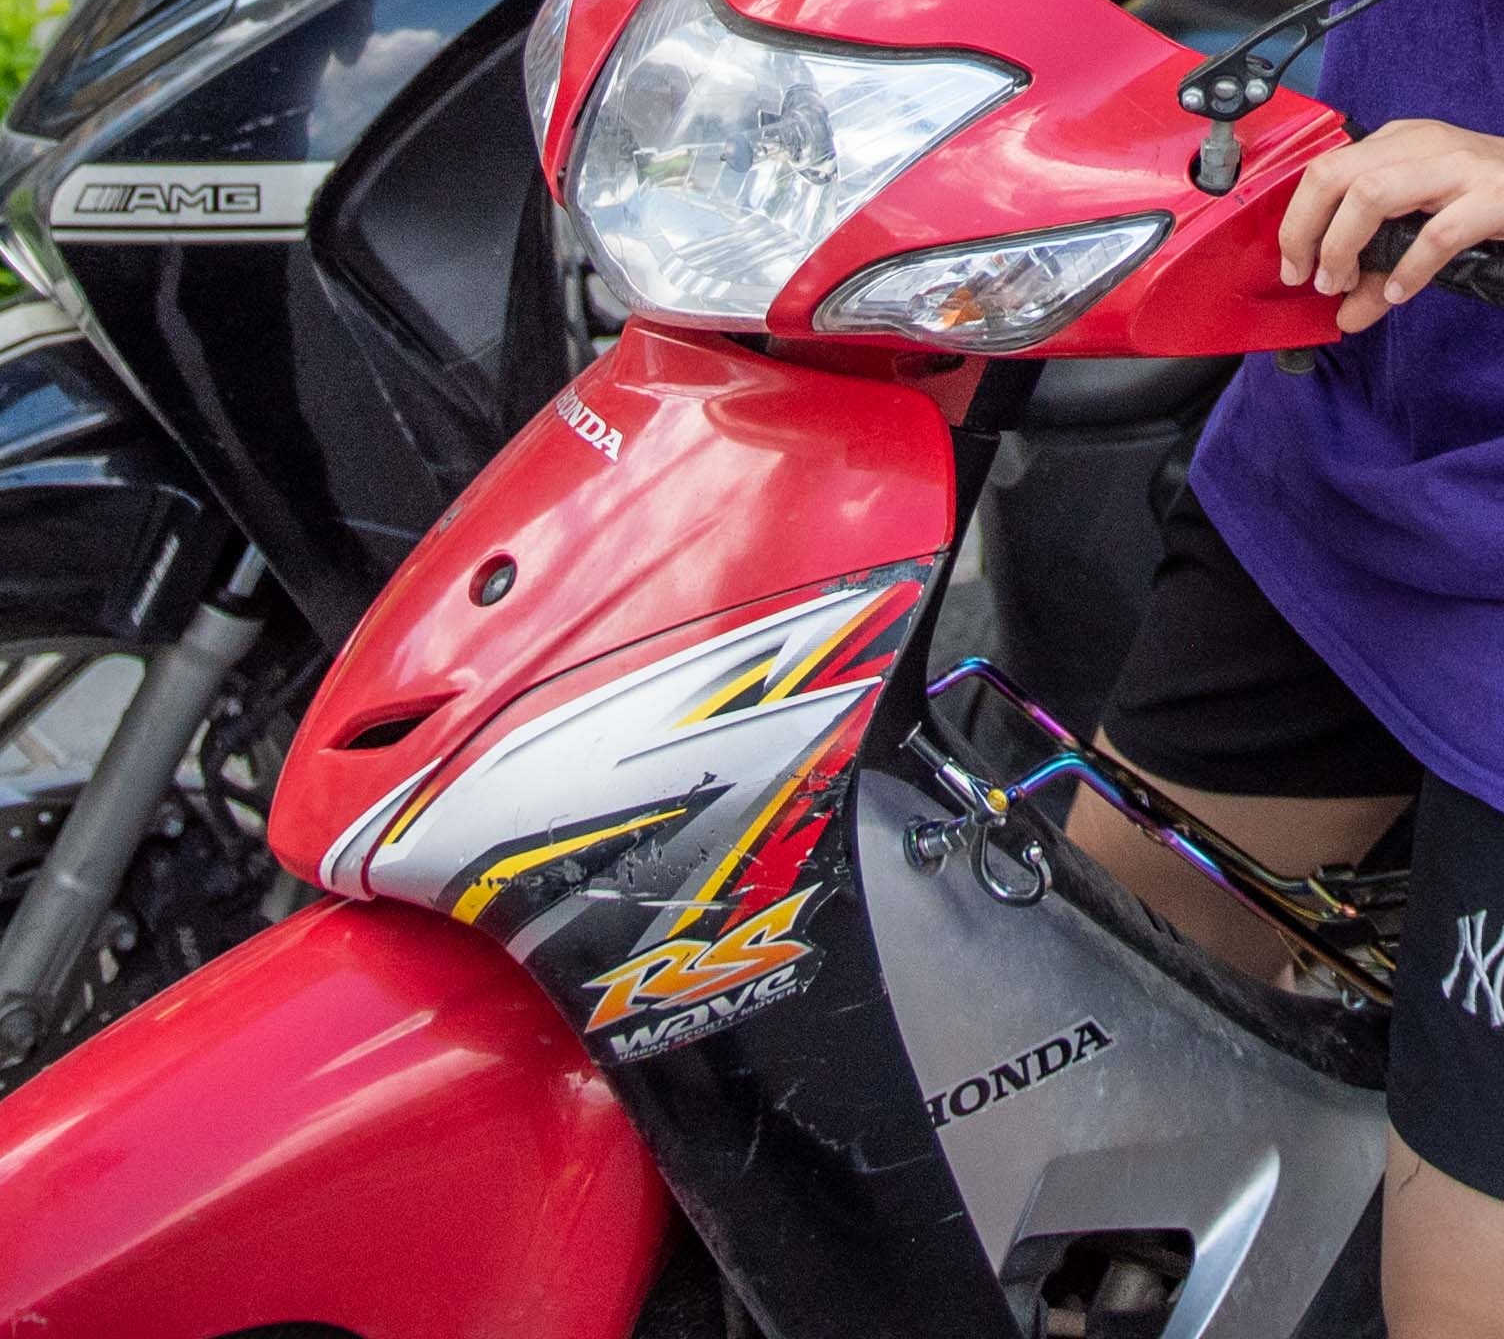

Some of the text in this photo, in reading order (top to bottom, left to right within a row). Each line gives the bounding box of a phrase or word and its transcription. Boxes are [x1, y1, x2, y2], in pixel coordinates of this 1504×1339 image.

[125, 183, 261, 214] AMG
[556, 387, 624, 462] HONDA
[581, 881, 824, 1034] RS
[618, 1039, 671, 1062] URBAN
[674, 1011, 736, 1043] SPORTY
